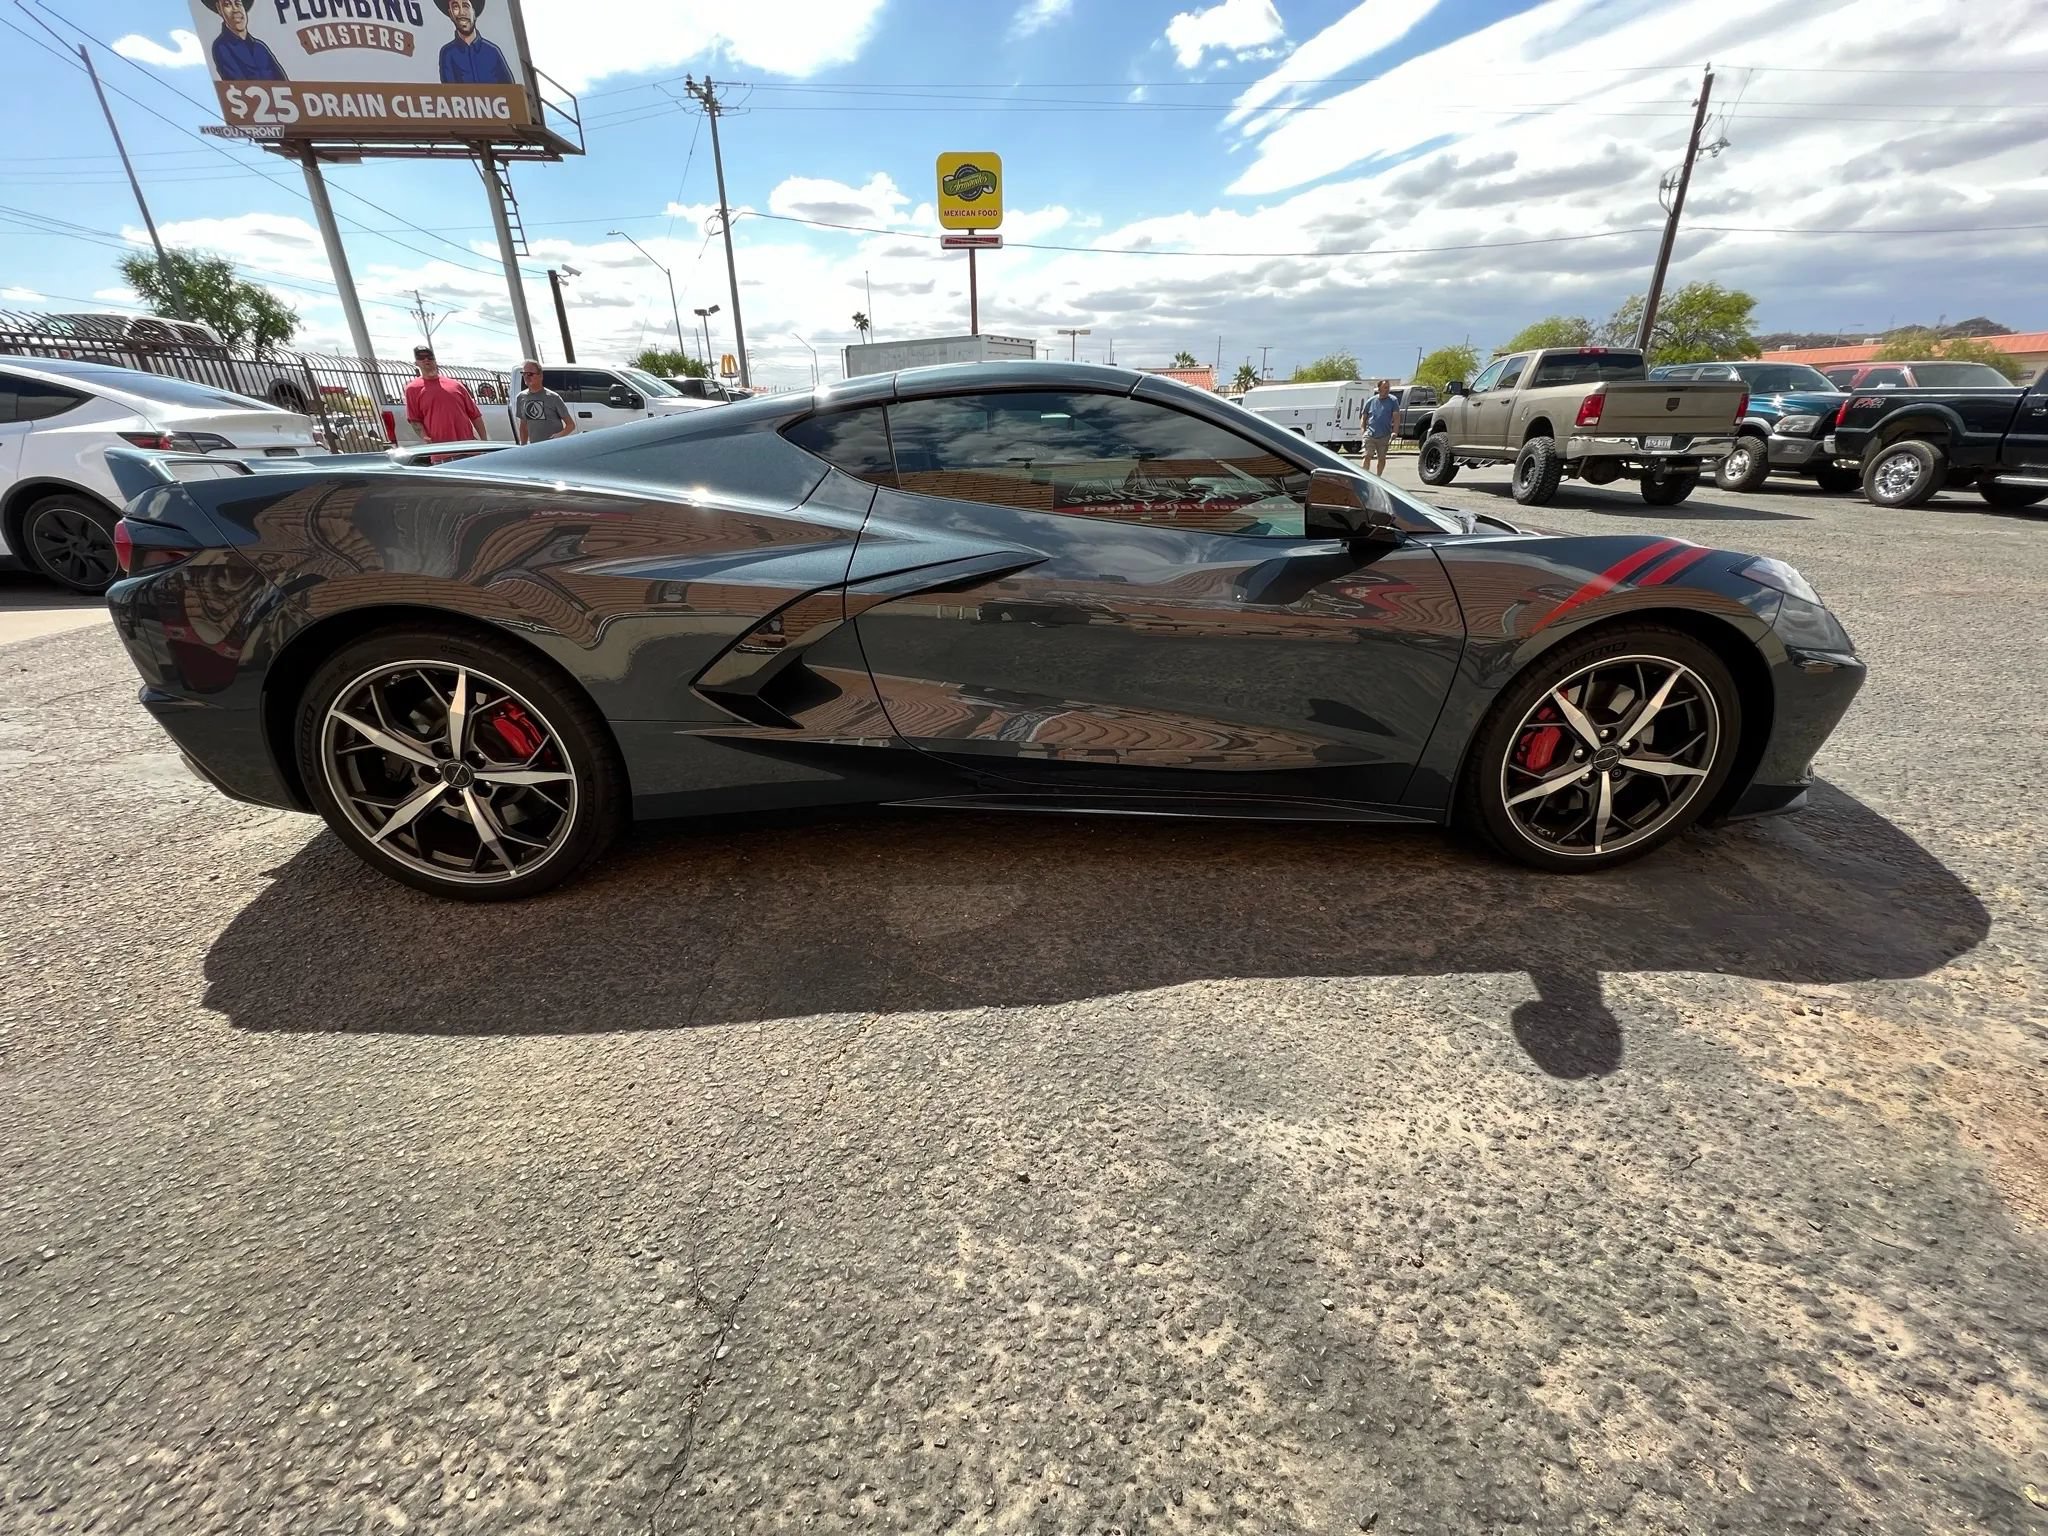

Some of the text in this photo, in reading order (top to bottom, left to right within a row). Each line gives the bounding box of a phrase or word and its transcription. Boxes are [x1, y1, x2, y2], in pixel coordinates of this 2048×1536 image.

[274, 0, 424, 27] PLUMBING
[306, 24, 405, 51] MASTERS
[226, 84, 511, 124] $25 DRAIN CLEARING
[223, 126, 281, 138] OUTFRONT
[943, 209, 998, 217] MEXICAN FOOD
